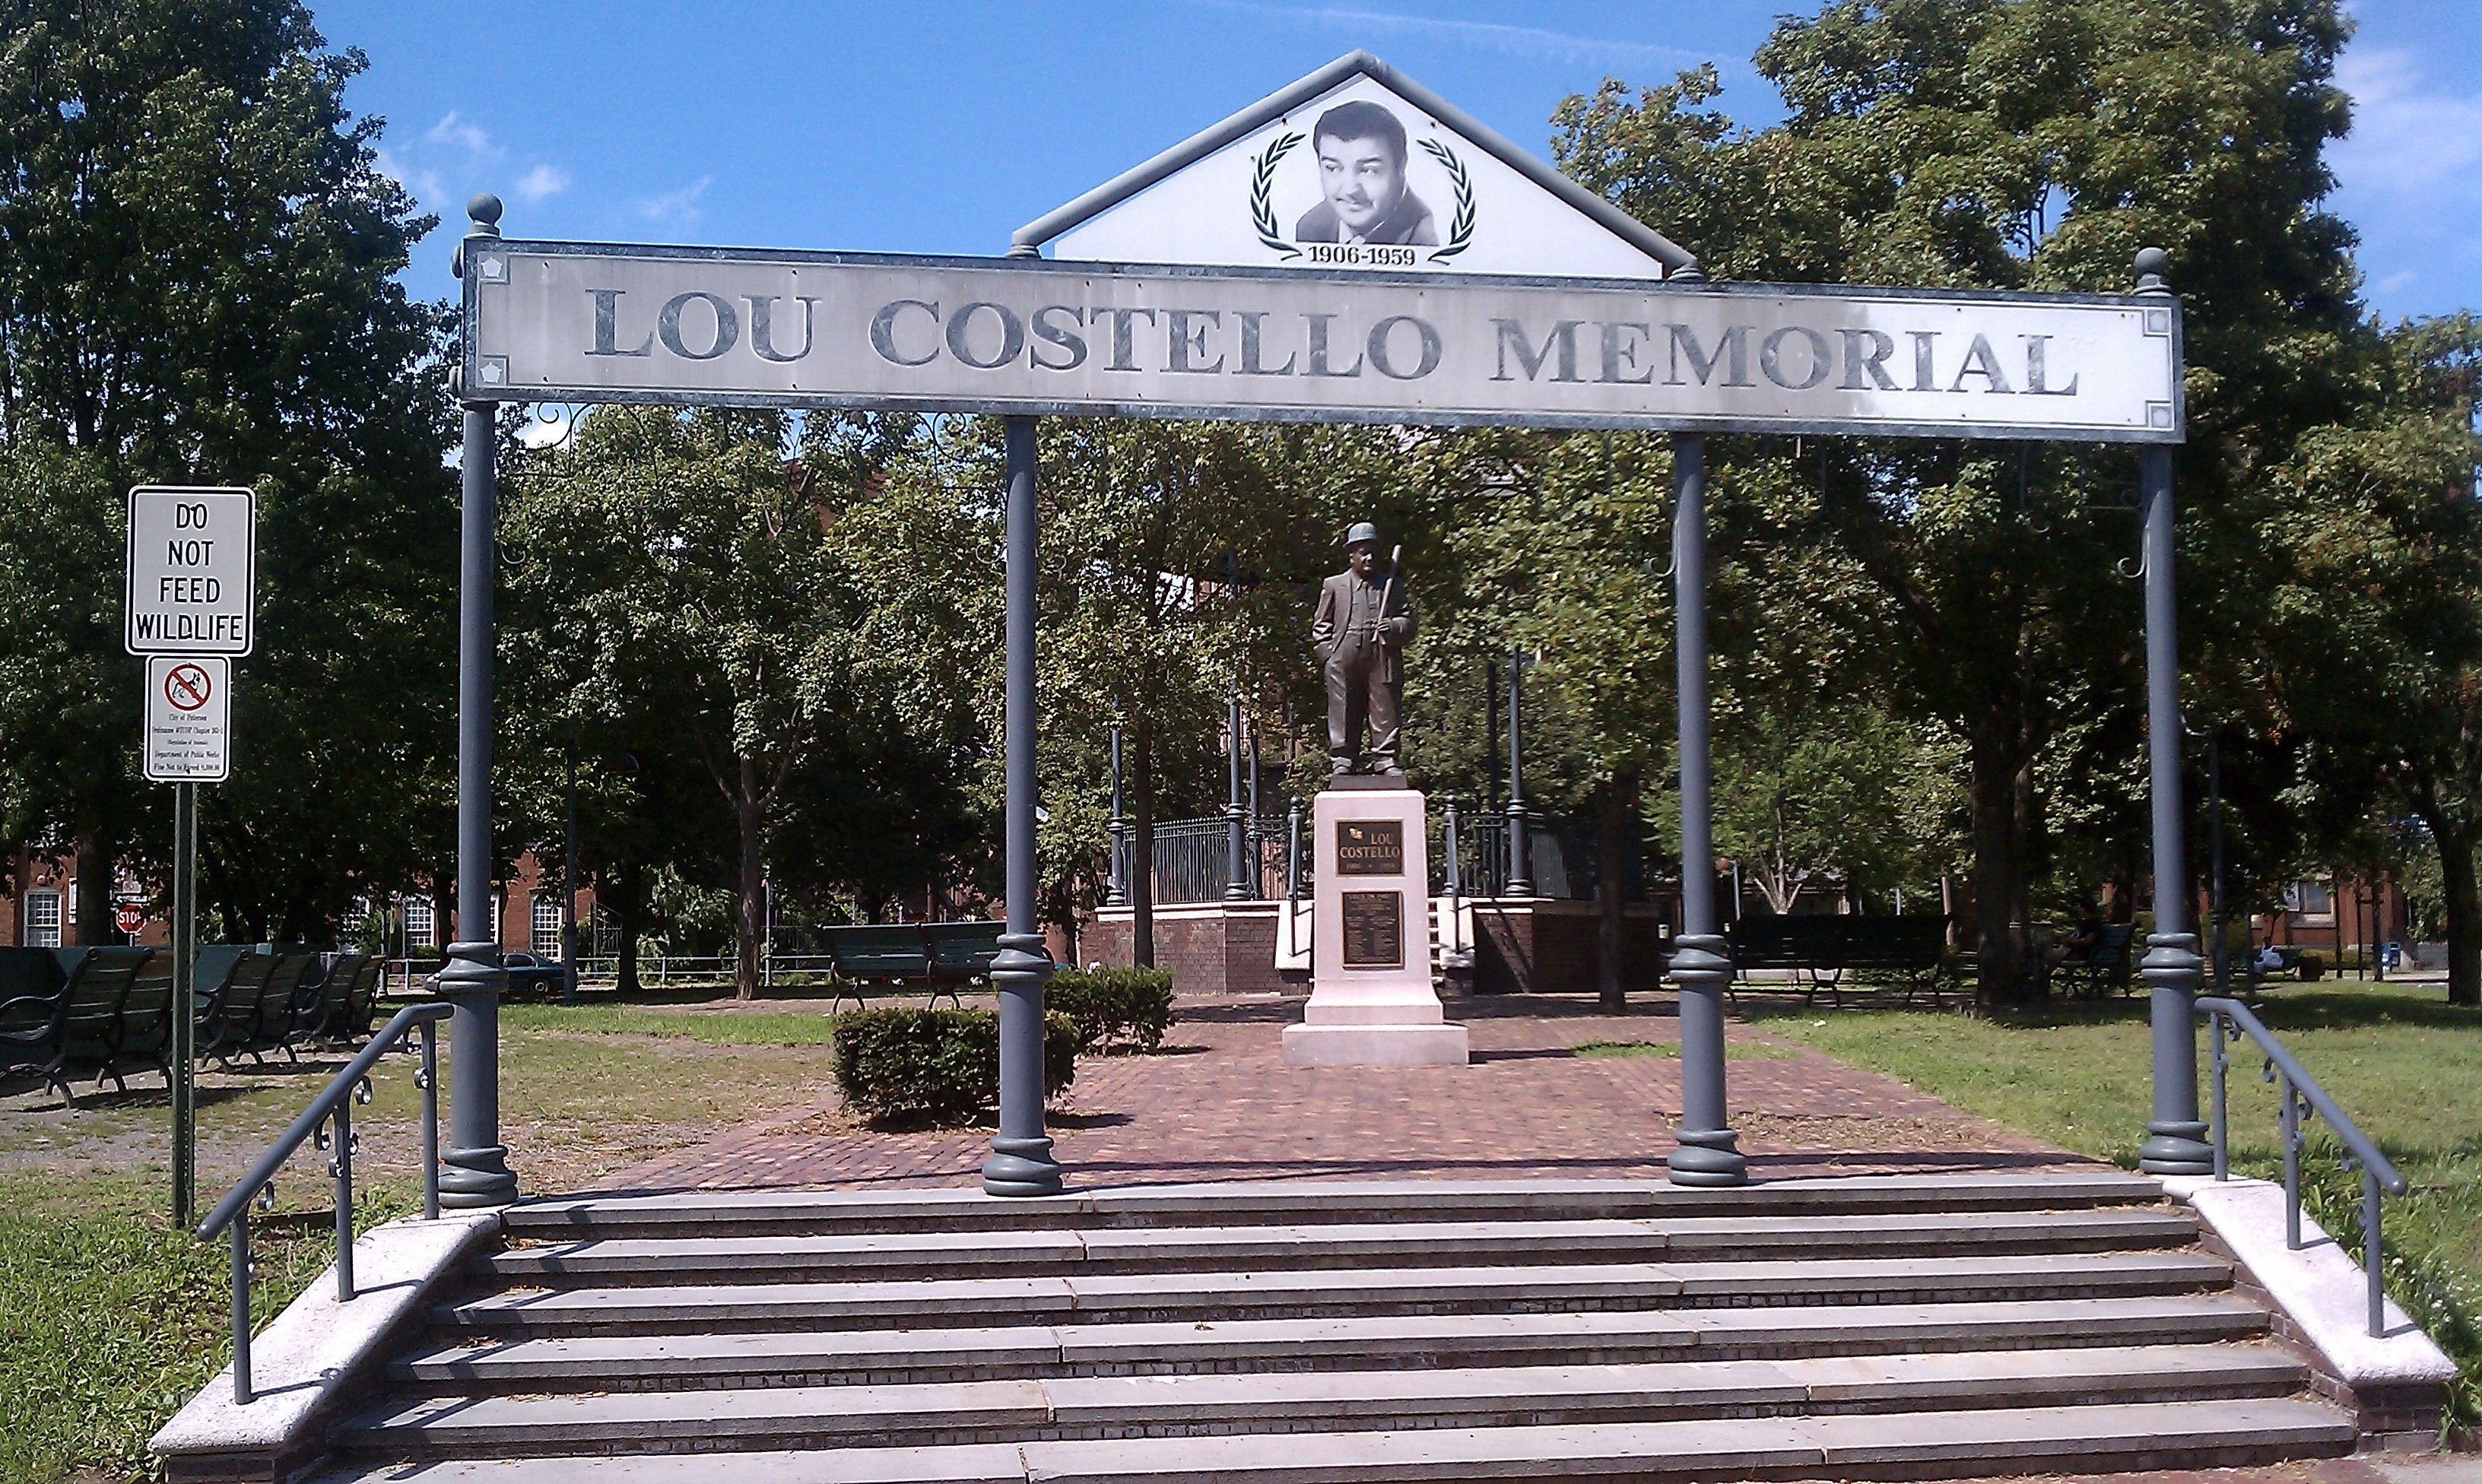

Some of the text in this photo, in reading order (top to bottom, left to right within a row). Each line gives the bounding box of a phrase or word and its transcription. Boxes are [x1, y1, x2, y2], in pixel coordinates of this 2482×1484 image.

[1308, 245, 1416, 265] 1906-1959
[584, 288, 2079, 397] LOU COSTELLO MEMORIAL
[176, 503, 208, 529] DO
[168, 540, 214, 566] NOT
[160, 576, 221, 603] FEED
[136, 614, 243, 640] WILDLIFE
[1340, 846, 1400, 858] COSTELLO
[1371, 833, 1393, 845] LOU
[119, 911, 142, 924] STO
